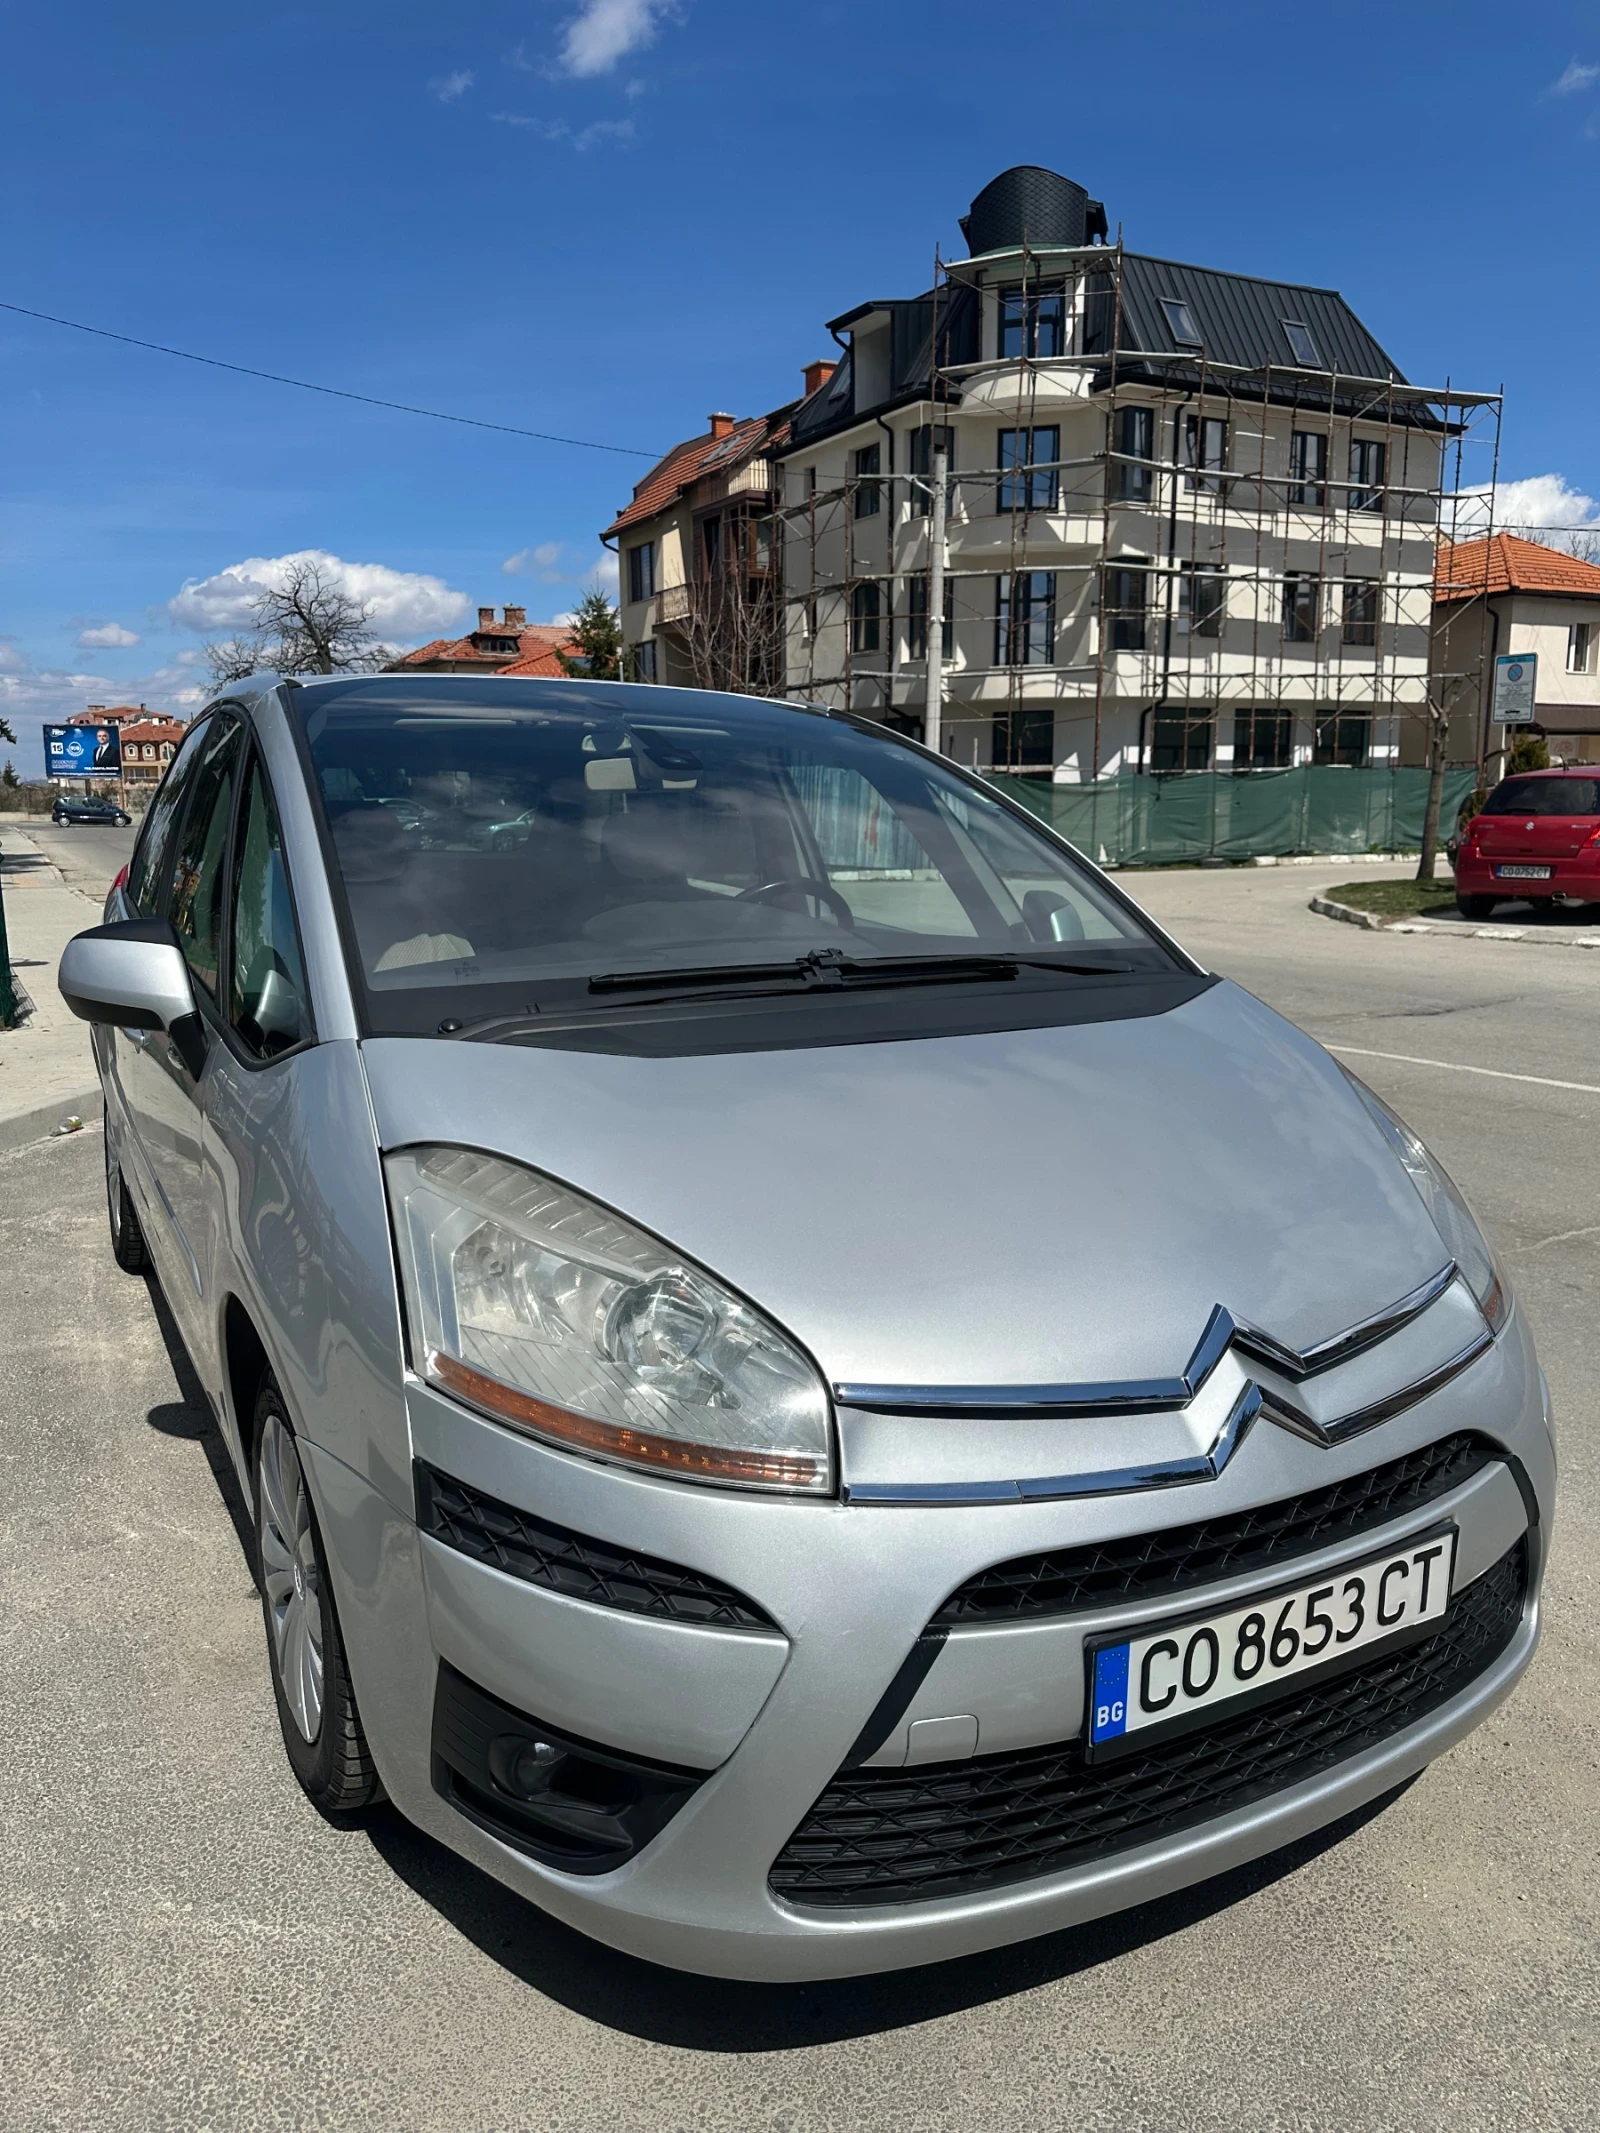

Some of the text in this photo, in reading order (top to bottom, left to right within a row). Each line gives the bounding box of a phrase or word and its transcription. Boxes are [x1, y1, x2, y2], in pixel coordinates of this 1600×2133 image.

[52, 744, 63, 752] 15
[1139, 1546, 1443, 1713] CO 8653 CT
[1096, 1701, 1124, 1728] BG
